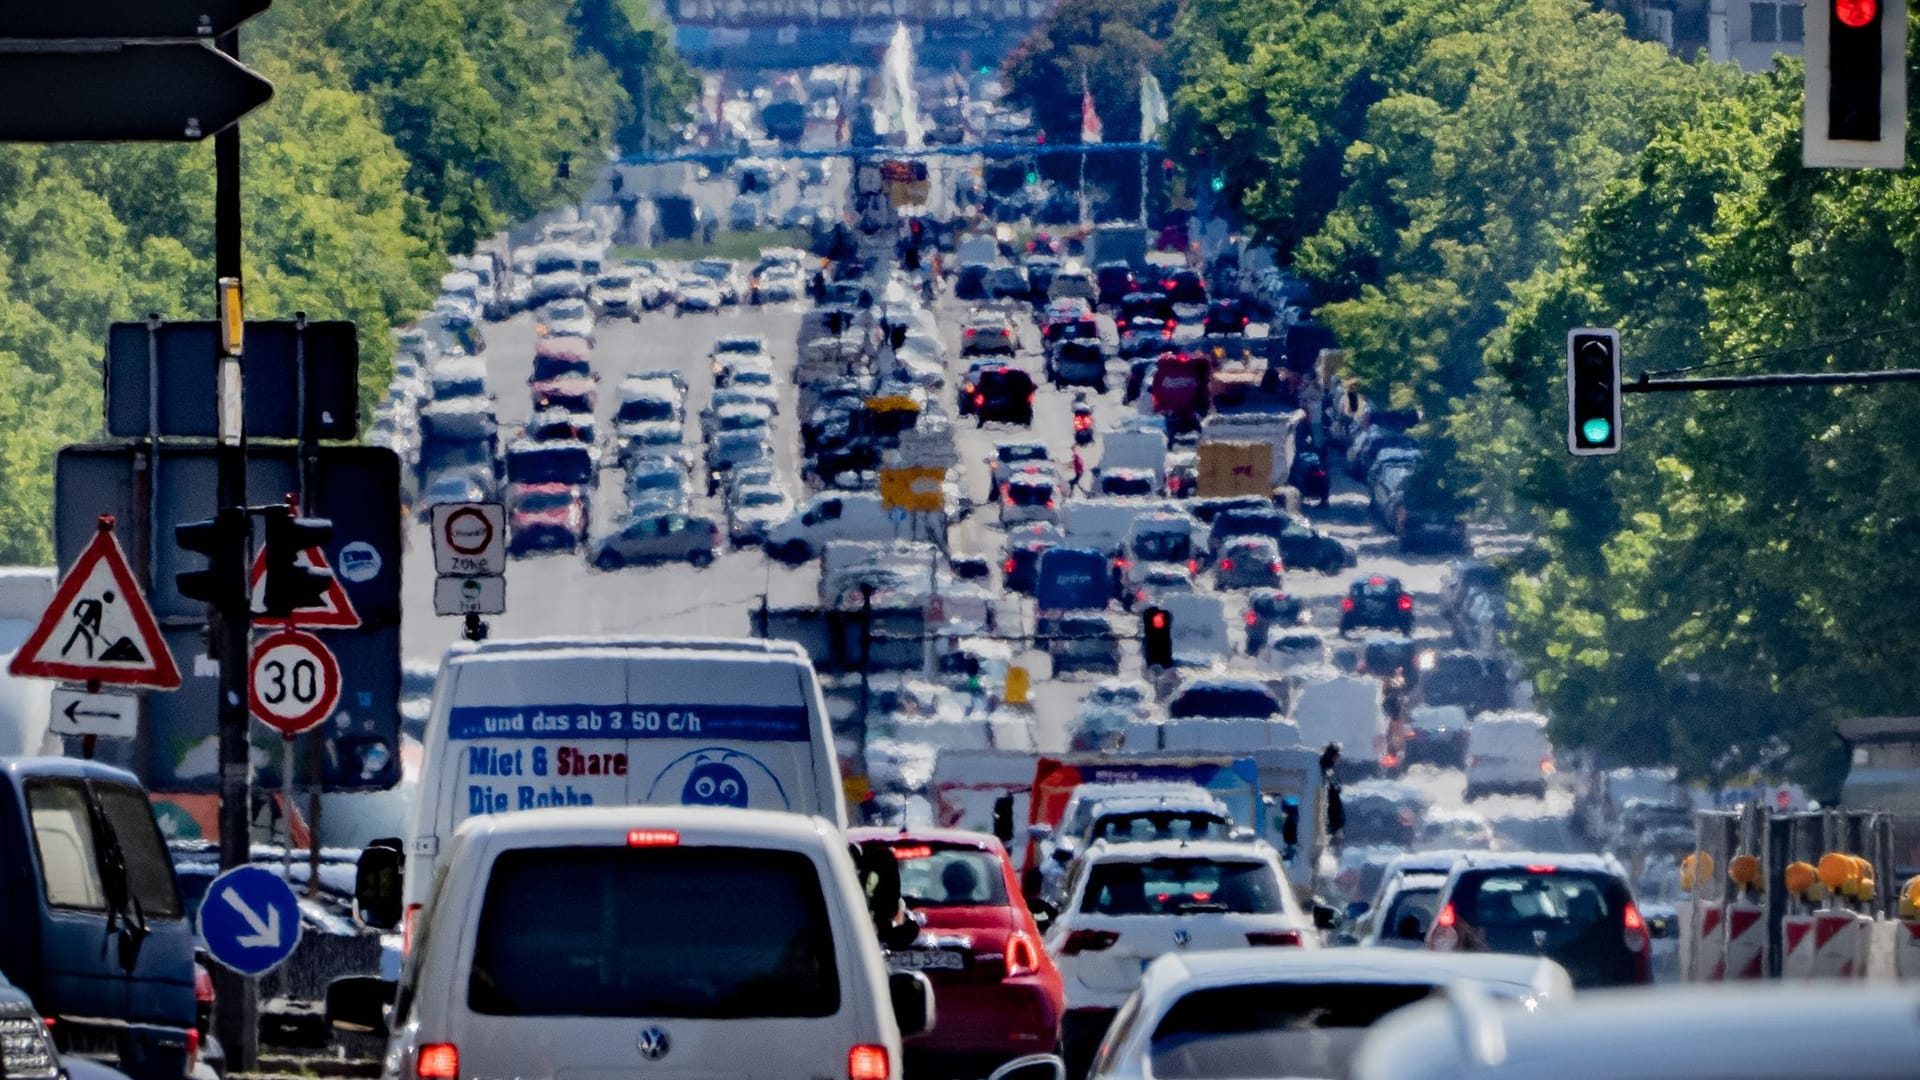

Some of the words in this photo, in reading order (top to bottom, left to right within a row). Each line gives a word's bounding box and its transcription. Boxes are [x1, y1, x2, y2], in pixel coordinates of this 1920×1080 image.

[264, 659, 317, 704] 30
[532, 712, 570, 732] das
[576, 711, 602, 731] ab
[469, 746, 523, 776] Miet
[532, 746, 548, 776] &
[557, 746, 628, 776] Share
[469, 785, 509, 814] Die
